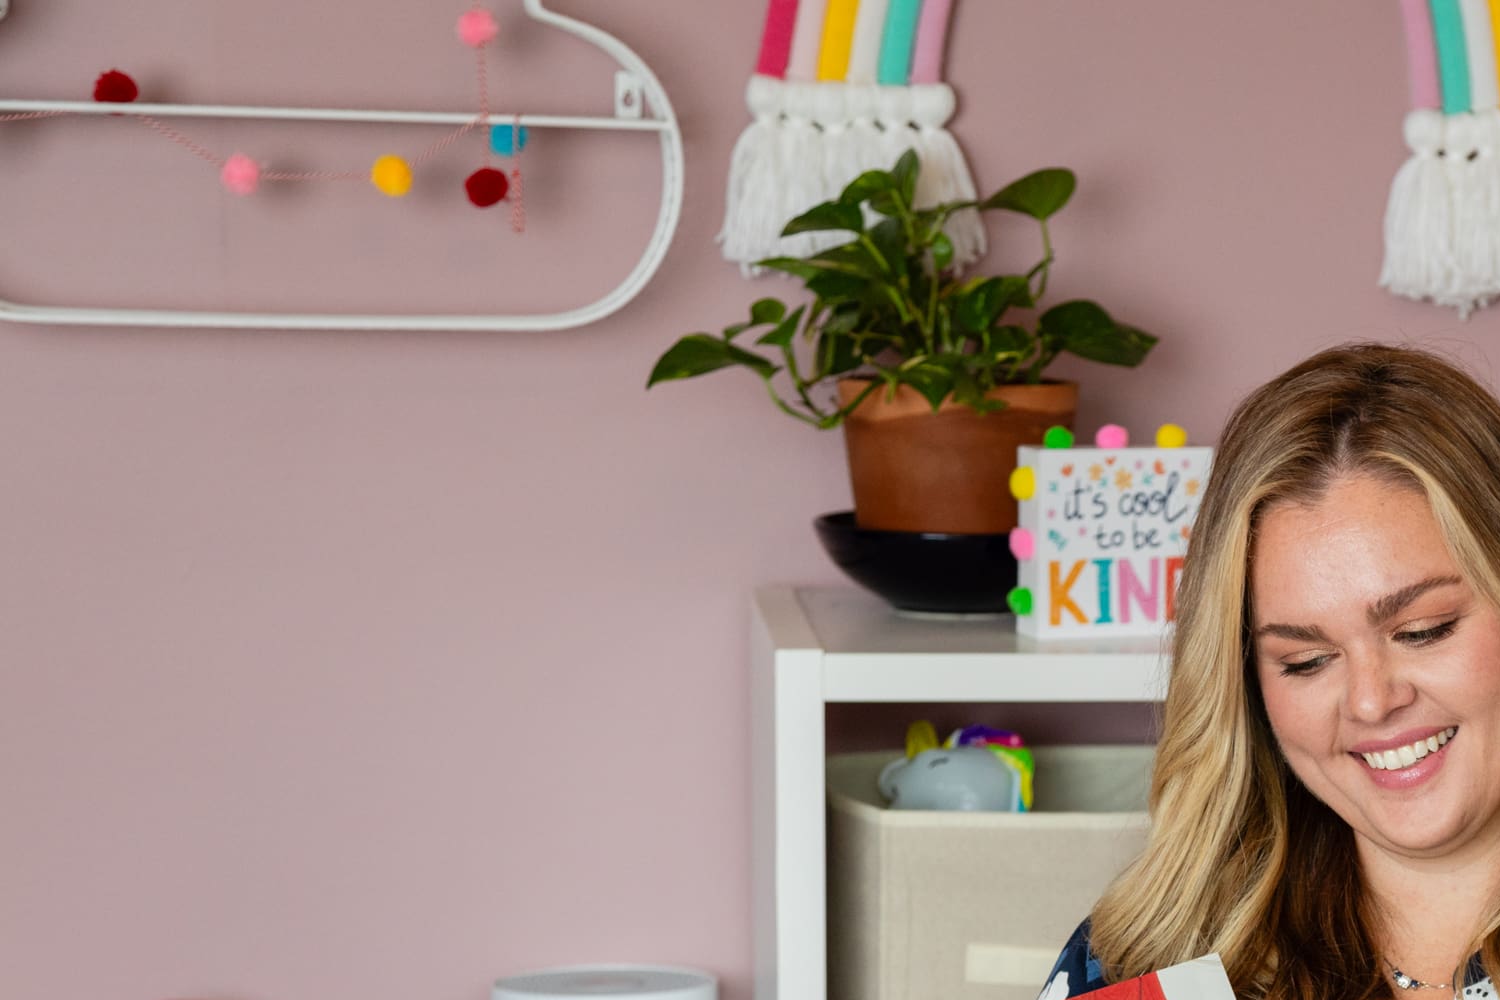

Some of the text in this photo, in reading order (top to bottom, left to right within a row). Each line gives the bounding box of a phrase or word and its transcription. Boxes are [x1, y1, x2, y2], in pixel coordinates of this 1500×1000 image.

[1063, 471, 1189, 523] it's cool
[1094, 520, 1163, 550] to be
